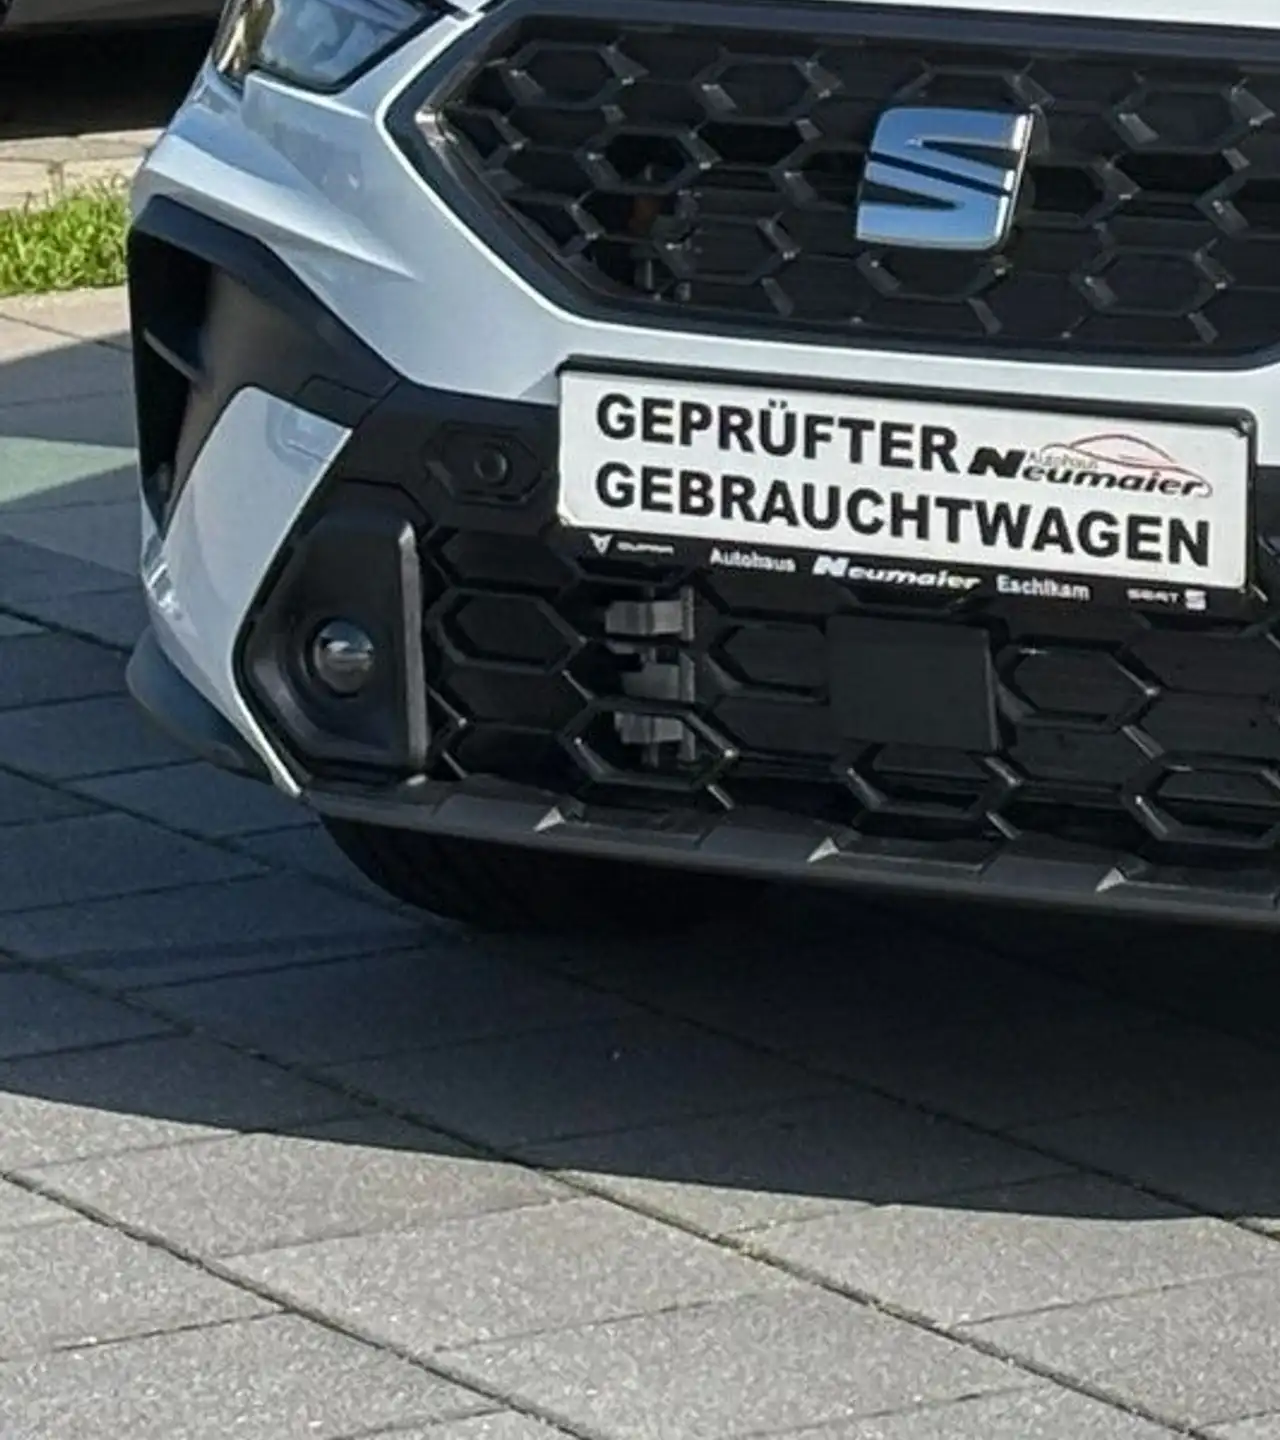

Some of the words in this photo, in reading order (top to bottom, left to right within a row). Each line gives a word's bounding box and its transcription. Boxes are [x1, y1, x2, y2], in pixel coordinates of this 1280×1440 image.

[595, 392, 960, 476] GEPRÜFTER
[967, 446, 1206, 498] Neumaier
[594, 461, 1211, 568] GEBRAUCHTWAGEN
[709, 546, 798, 574] Autohaus
[811, 554, 982, 592] Neumaier
